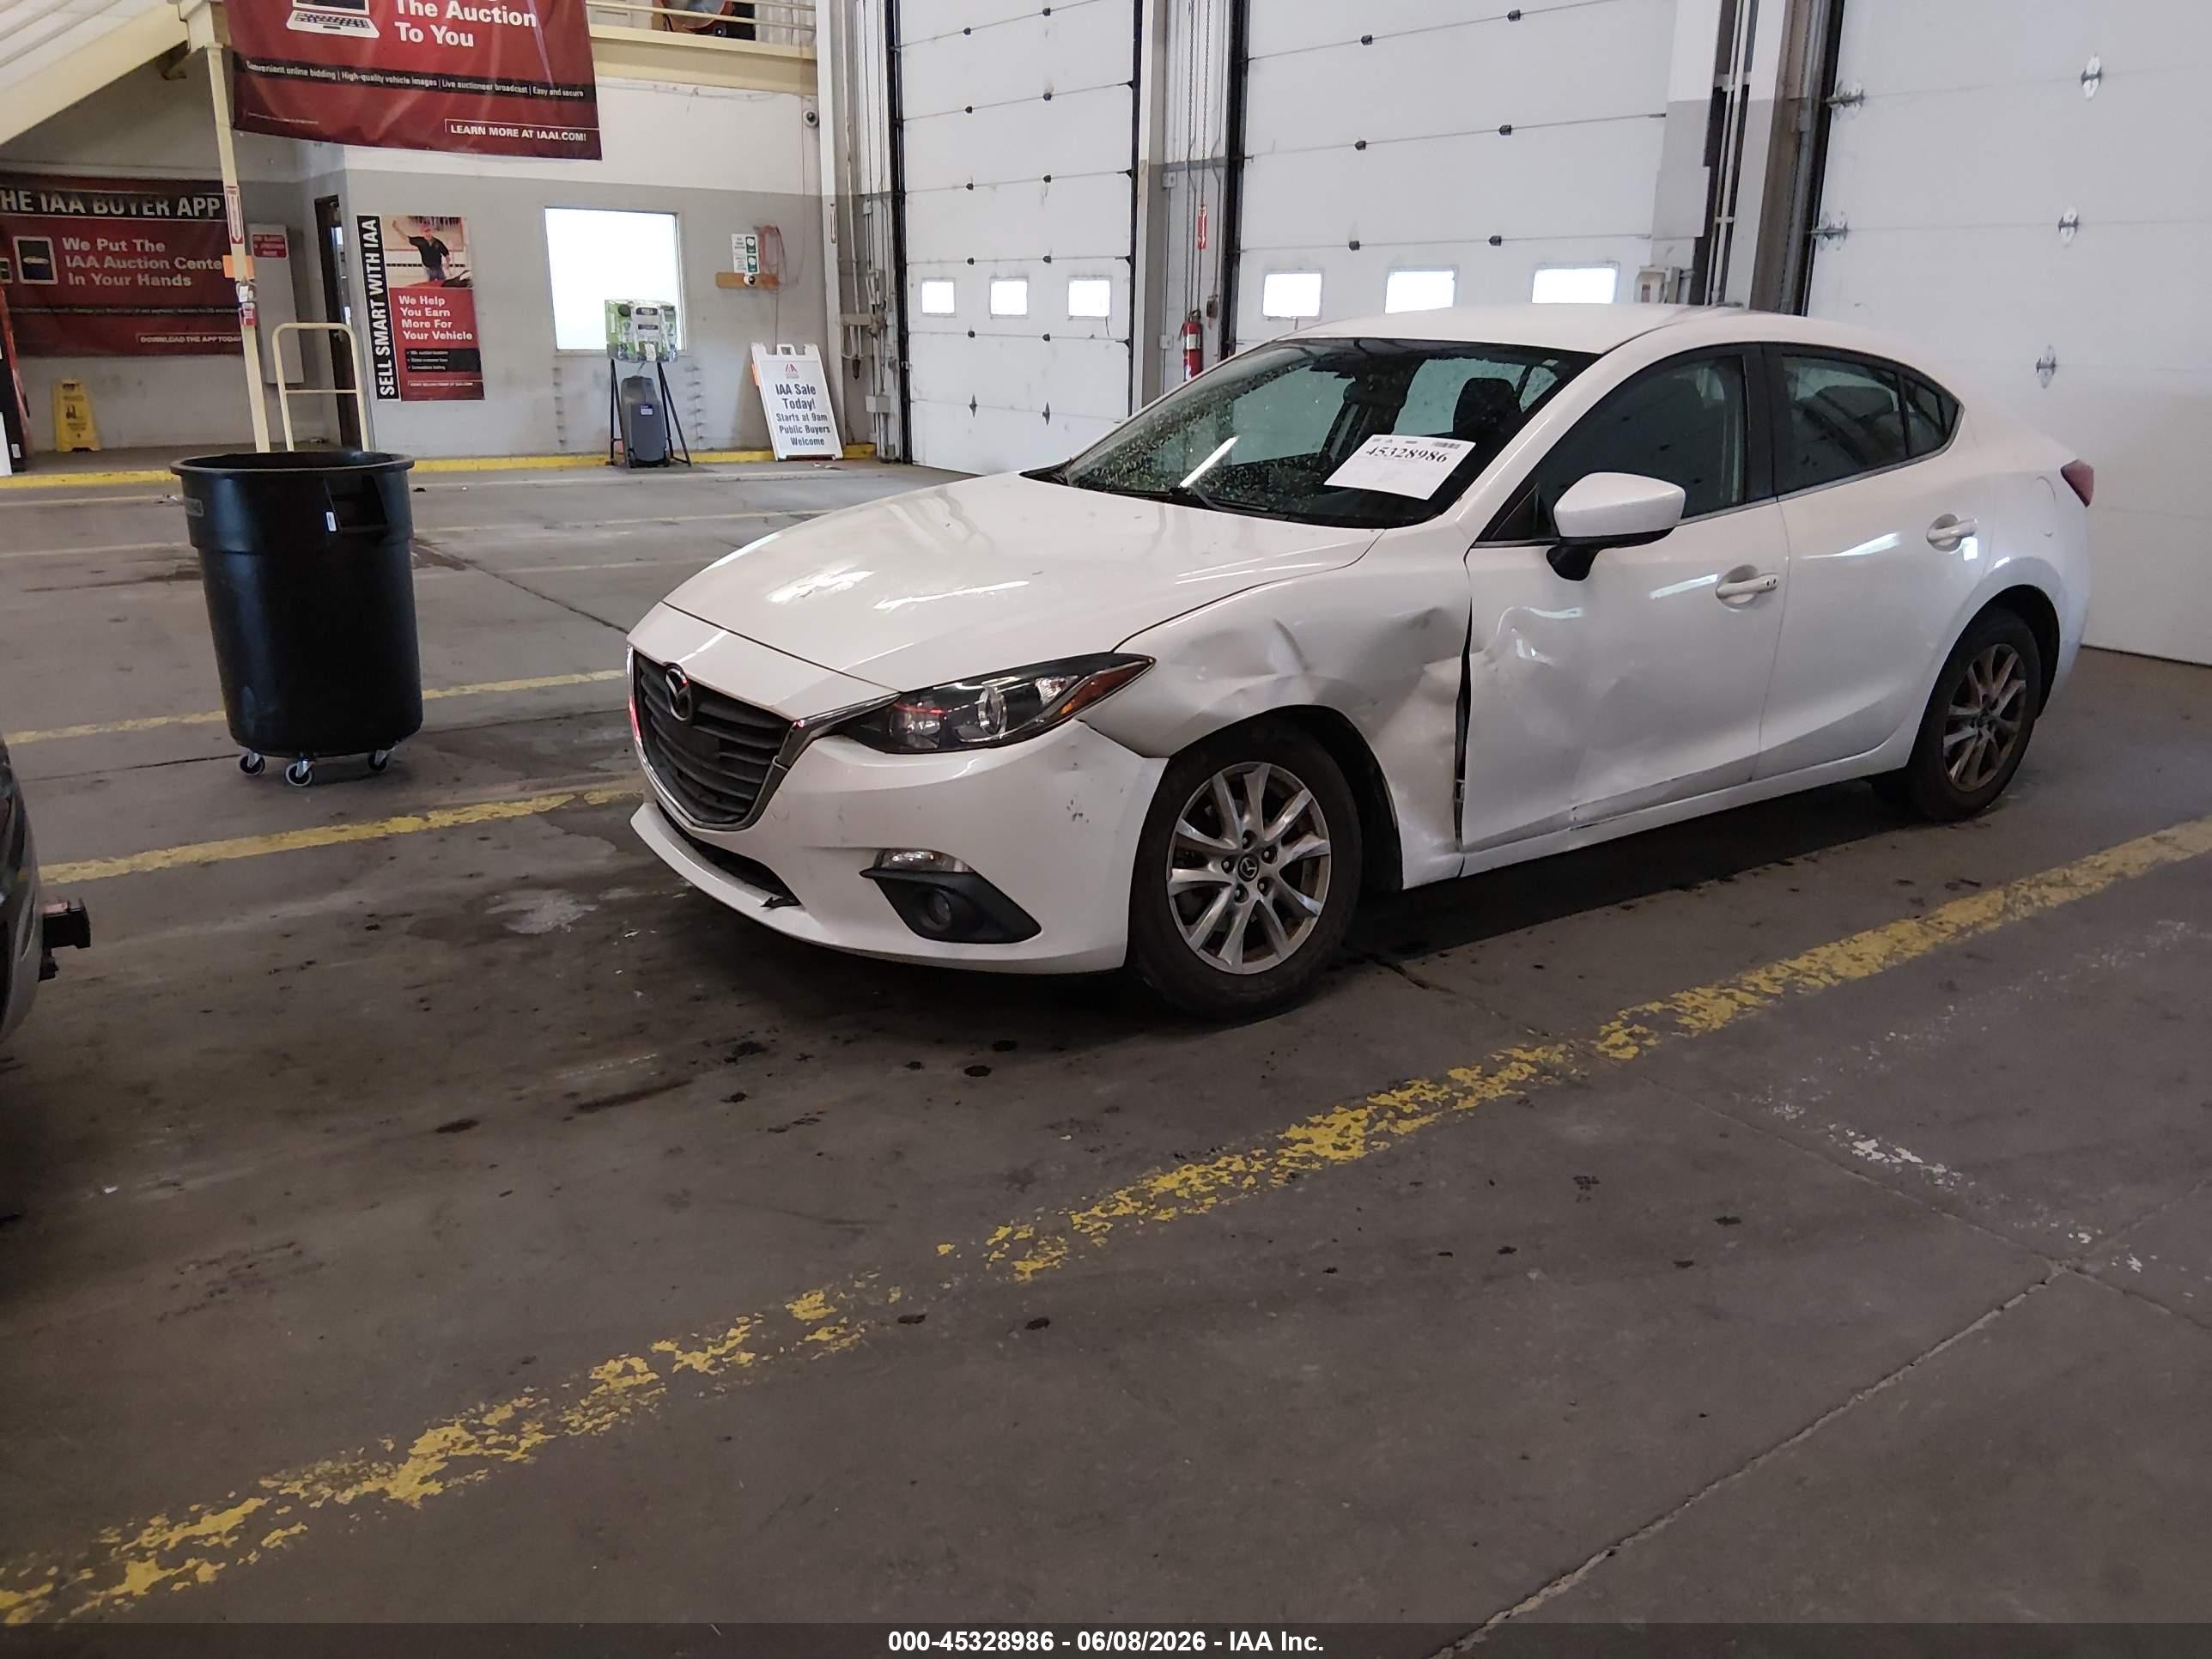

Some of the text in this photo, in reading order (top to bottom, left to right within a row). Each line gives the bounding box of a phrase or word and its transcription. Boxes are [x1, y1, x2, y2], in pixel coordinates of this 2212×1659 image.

[446, 0, 538, 27] Auction
[394, 21, 474, 47] To You
[286, 67, 308, 76] online
[309, 68, 336, 80] bidding
[342, 71, 384, 83] High-quality
[385, 76, 410, 84] vehicle
[411, 77, 437, 87] images
[442, 79, 456, 88] Live
[457, 82, 493, 90] auctioneer
[495, 83, 528, 94] broadcast
[532, 86, 548, 96] Easy
[450, 124, 486, 135] LEARN
[489, 126, 520, 137] MORE
[521, 129, 534, 138] AT
[40, 191, 86, 214] IAA
[177, 197, 221, 217] APP
[62, 237, 166, 252] We Put The
[65, 256, 222, 270] IAA Auction Cente
[69, 272, 192, 288] In Your Hands
[362, 219, 395, 396] SELL SMART WITH IAA
[398, 295, 445, 307] We Help
[400, 307, 451, 317] You Earn
[401, 319, 453, 328] More For
[403, 331, 473, 340] Your Vehicle
[775, 383, 817, 395] IAA Sale
[782, 398, 816, 410] Today!
[776, 412, 828, 422] Starts at 9am
[779, 425, 830, 434] Public Buyers
[791, 437, 825, 446] Welcome
[1365, 447, 1449, 464] 45328986
